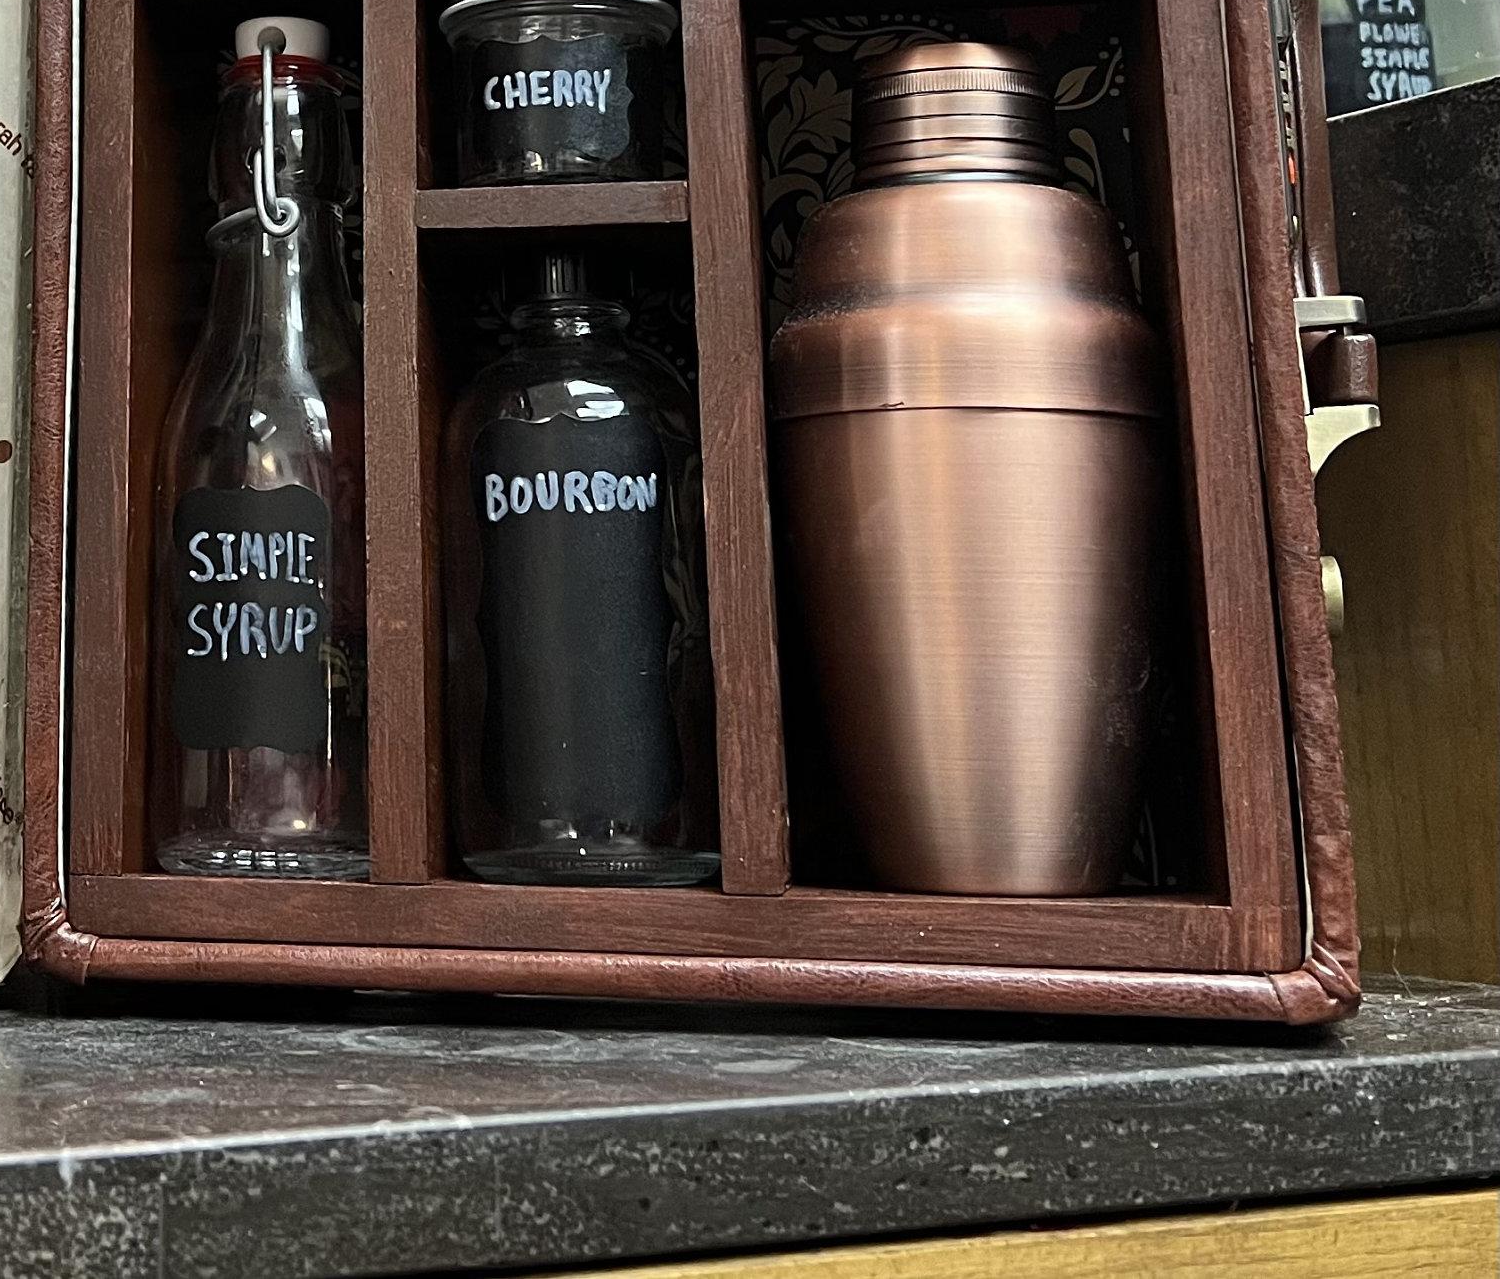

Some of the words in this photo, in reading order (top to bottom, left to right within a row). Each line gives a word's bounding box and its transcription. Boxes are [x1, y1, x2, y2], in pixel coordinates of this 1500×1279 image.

[1361, 46, 1430, 70] SIMPLE
[484, 68, 612, 115] CHERRY
[485, 470, 657, 522] BOURBON
[188, 530, 316, 583] SIMPLE
[187, 602, 318, 662] SYRUP
